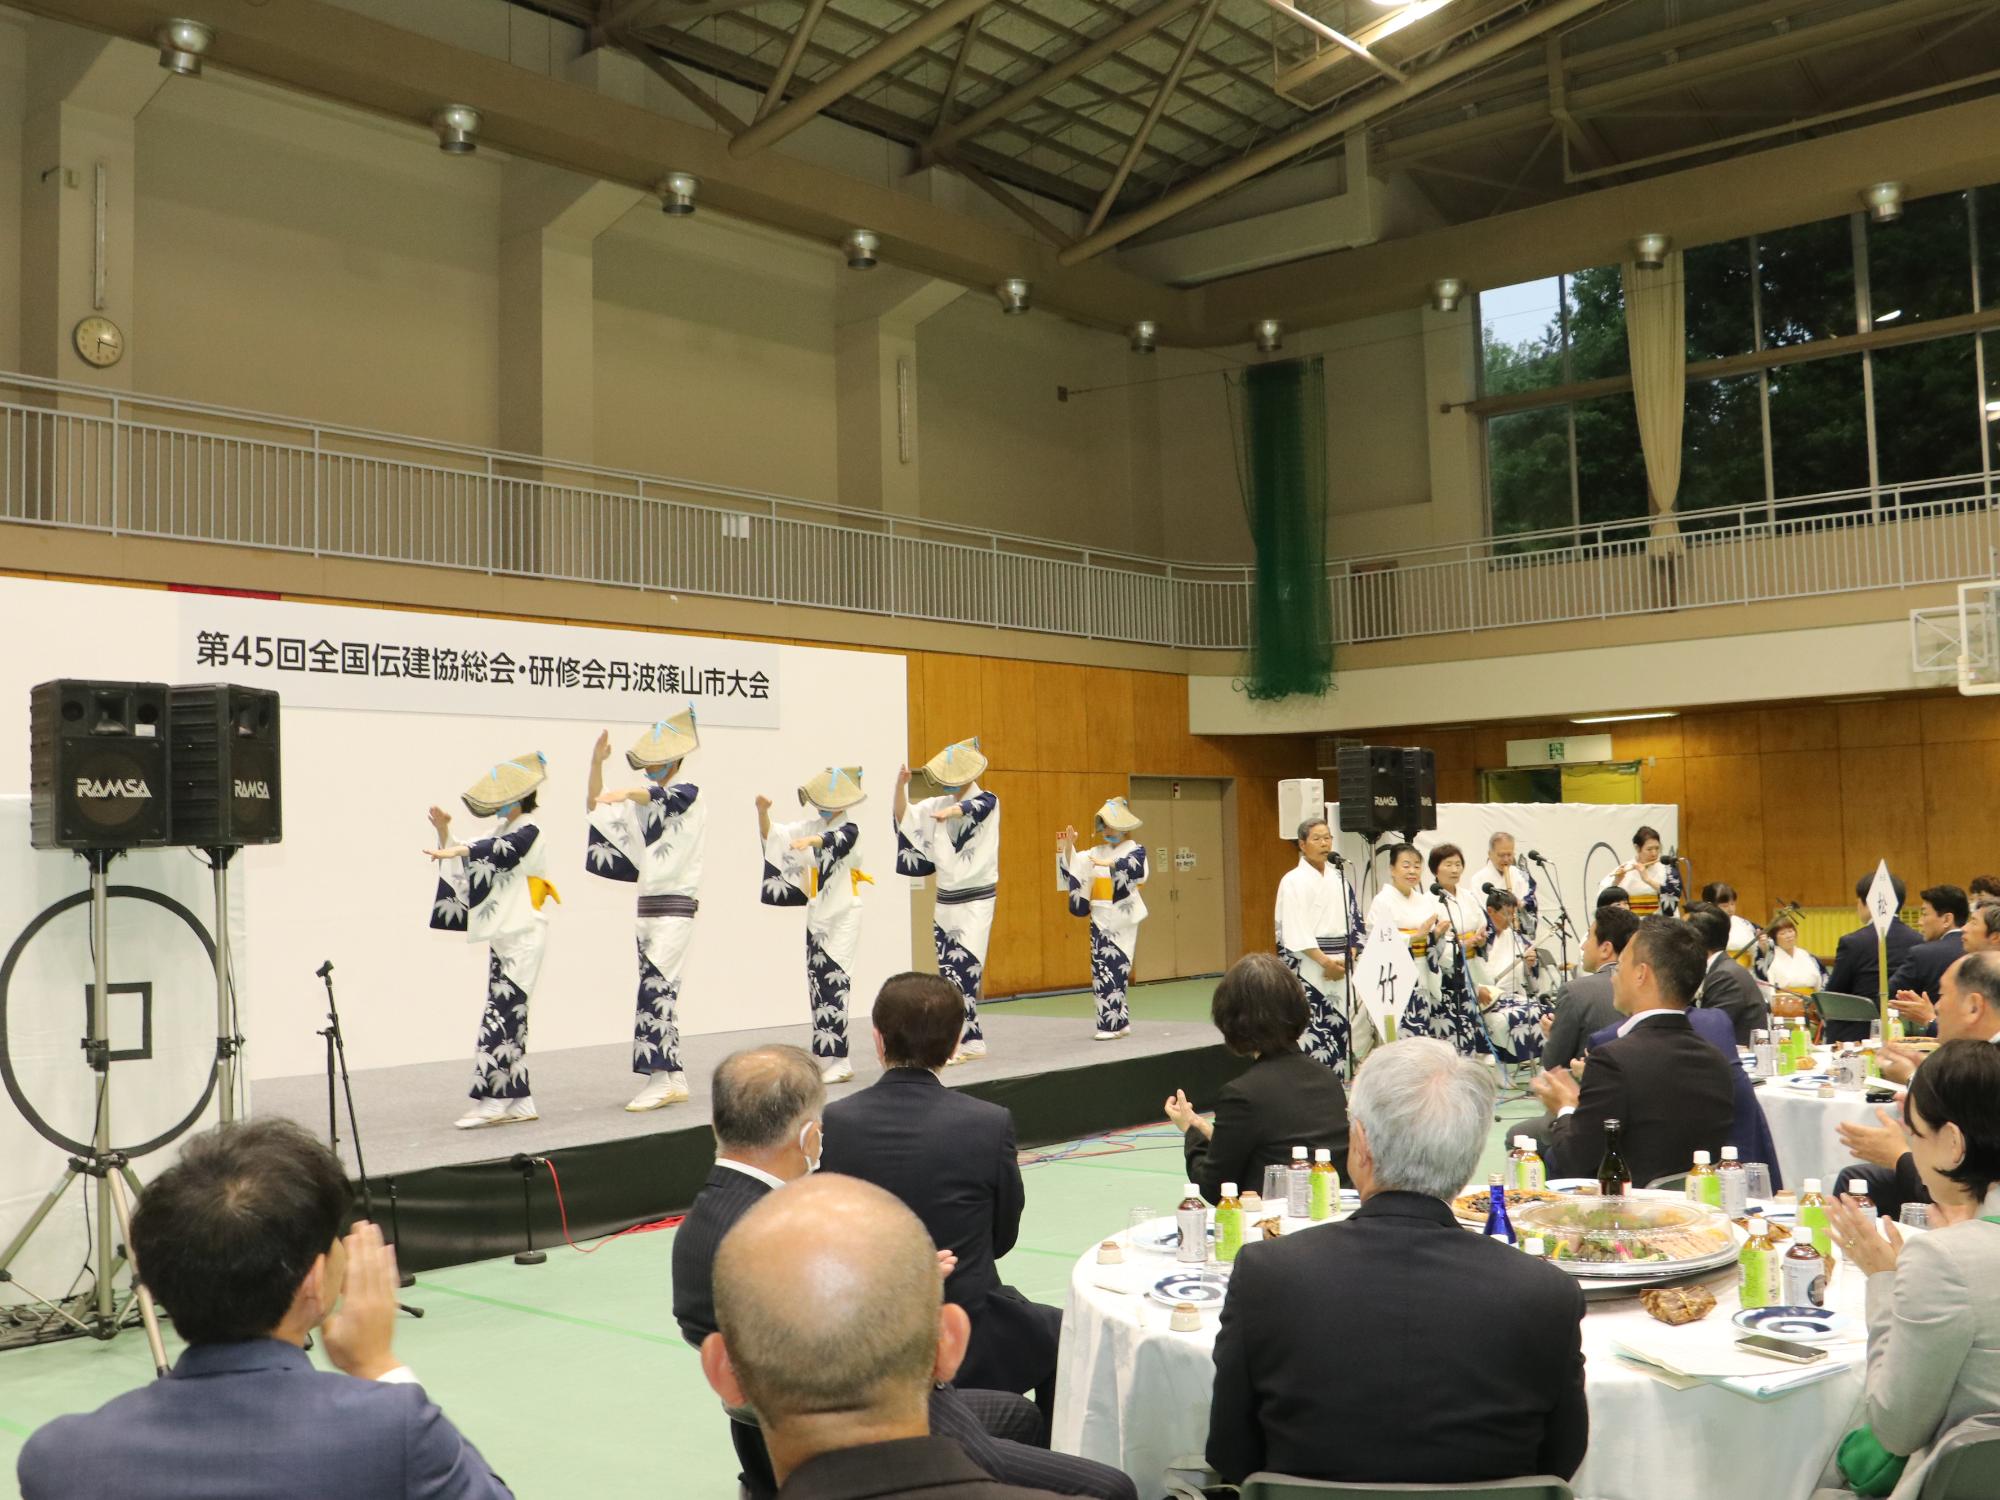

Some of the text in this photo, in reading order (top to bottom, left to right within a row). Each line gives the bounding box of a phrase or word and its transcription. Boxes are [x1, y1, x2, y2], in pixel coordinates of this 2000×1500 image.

[196, 630, 770, 700] 第45回全国伝建協総会・研修会丹波篠山市大会
[76, 777, 153, 798] RAMSA
[234, 779, 270, 799] RAMSA
[1374, 796, 1399, 806] RAMSA
[1376, 961, 1398, 1005] 竹
